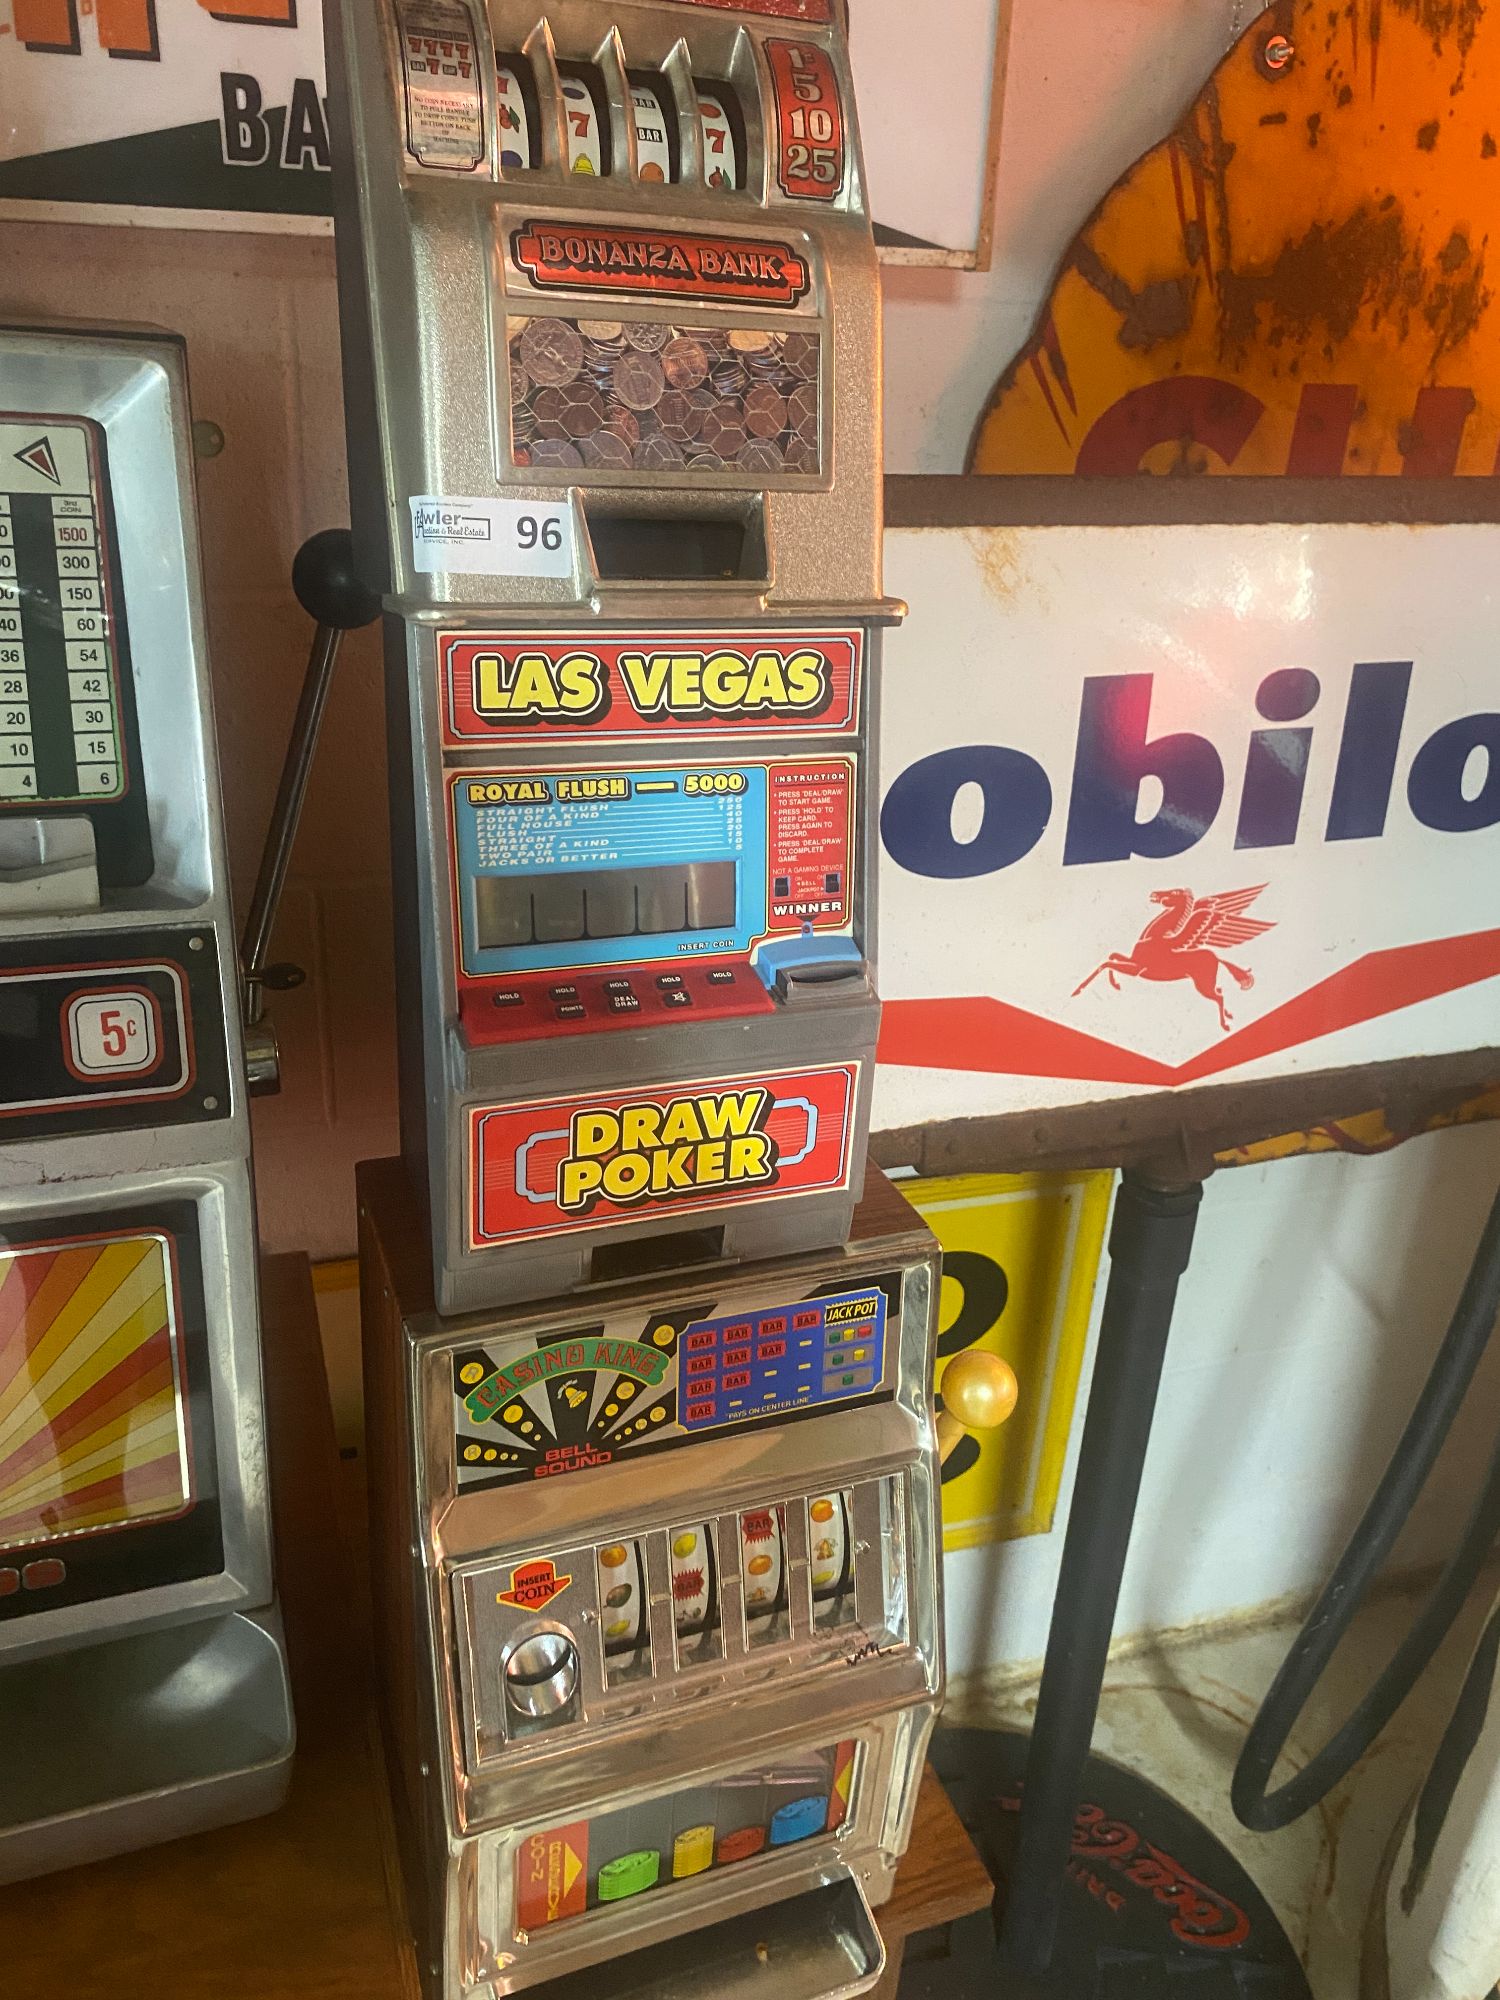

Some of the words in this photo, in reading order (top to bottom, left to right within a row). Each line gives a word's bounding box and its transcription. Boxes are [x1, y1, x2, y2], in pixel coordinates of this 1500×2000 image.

[792, 73, 823, 104] 5
[568, 110, 590, 138] 7
[789, 107, 832, 142] 10
[638, 128, 661, 142] BAR
[705, 128, 726, 154] 7
[786, 144, 837, 183] 25
[540, 235, 691, 273] BONANZA
[698, 247, 783, 282] BANK
[58, 527, 88, 542] 1500
[447, 526, 464, 536] Real
[516, 515, 563, 551] 96
[62, 556, 90, 570] 300
[67, 587, 93, 601] 150
[77, 618, 96, 632] 60
[1, 649, 20, 663] 36
[79, 649, 98, 662] 54
[3, 680, 23, 693] 28
[82, 679, 101, 692] 42
[473, 653, 602, 717] LAS
[617, 648, 826, 713] VEGAS
[6, 712, 26, 725] 20
[85, 710, 104, 723] 30
[10, 743, 29, 757] 10
[88, 741, 106, 754] 15
[22, 775, 32, 788] 4
[100, 772, 110, 785] 6
[774, 773, 845, 783] INSTRUCTION
[467, 781, 549, 805] ROYAL
[555, 777, 629, 801] FLUSH
[684, 772, 747, 795] 5000
[476, 806, 555, 817] STRAIGHT
[561, 804, 609, 812] FLUSH
[477, 816, 518, 824] FOUR
[564, 812, 599, 820] KIND
[719, 803, 742, 811] 125
[477, 824, 518, 832] FULL
[521, 821, 573, 830] HOUSE
[477, 830, 528, 839] FLUSH
[478, 835, 556, 846] STRAIGHT
[479, 844, 529, 853] THREE
[574, 839, 609, 848] KIND
[518, 850, 552, 858] PAIR
[789, 846, 824, 854] COMPLETE
[479, 858, 529, 868] JACKS
[535, 856, 555, 864] OR
[561, 852, 617, 862] BETTER
[773, 901, 842, 916] WINNER
[677, 941, 709, 951] INSERT
[712, 939, 734, 949] COIN
[499, 992, 520, 1000] HOLD
[555, 986, 576, 995] HOLD
[609, 981, 630, 989] HOLD
[662, 976, 681, 984] HOLD
[713, 971, 732, 979] HOLD
[614, 995, 636, 1003] DEAL
[615, 1000, 639, 1008] DRAW
[561, 1004, 584, 1012] POINTS
[574, 1091, 764, 1159] DRAW
[560, 1135, 772, 1207] POKER
[691, 1336, 713, 1348] BAR
[727, 1329, 748, 1341] BAR
[763, 1321, 783, 1333] BAR
[797, 1314, 817, 1326] BAR
[827, 1306, 852, 1321] JACK
[854, 1301, 876, 1316] POT
[691, 1359, 712, 1372] BAR
[726, 1352, 747, 1364] BAR
[762, 1345, 782, 1357] BAR
[477, 1343, 586, 1409] CASINO
[593, 1341, 660, 1378] KING
[691, 1383, 712, 1395] BAR
[726, 1376, 746, 1388] BAR
[690, 1405, 711, 1417] BAR
[748, 1406, 761, 1416] ON
[761, 1400, 792, 1413] CENTER
[545, 1442, 599, 1462] BELL
[534, 1451, 613, 1478] SOUND
[746, 1517, 770, 1532] BAR
[517, 1572, 551, 1588] INSERT
[676, 1578, 699, 1592] BAR
[514, 1582, 556, 1603] COIN
[530, 1834, 545, 1883] COIN
